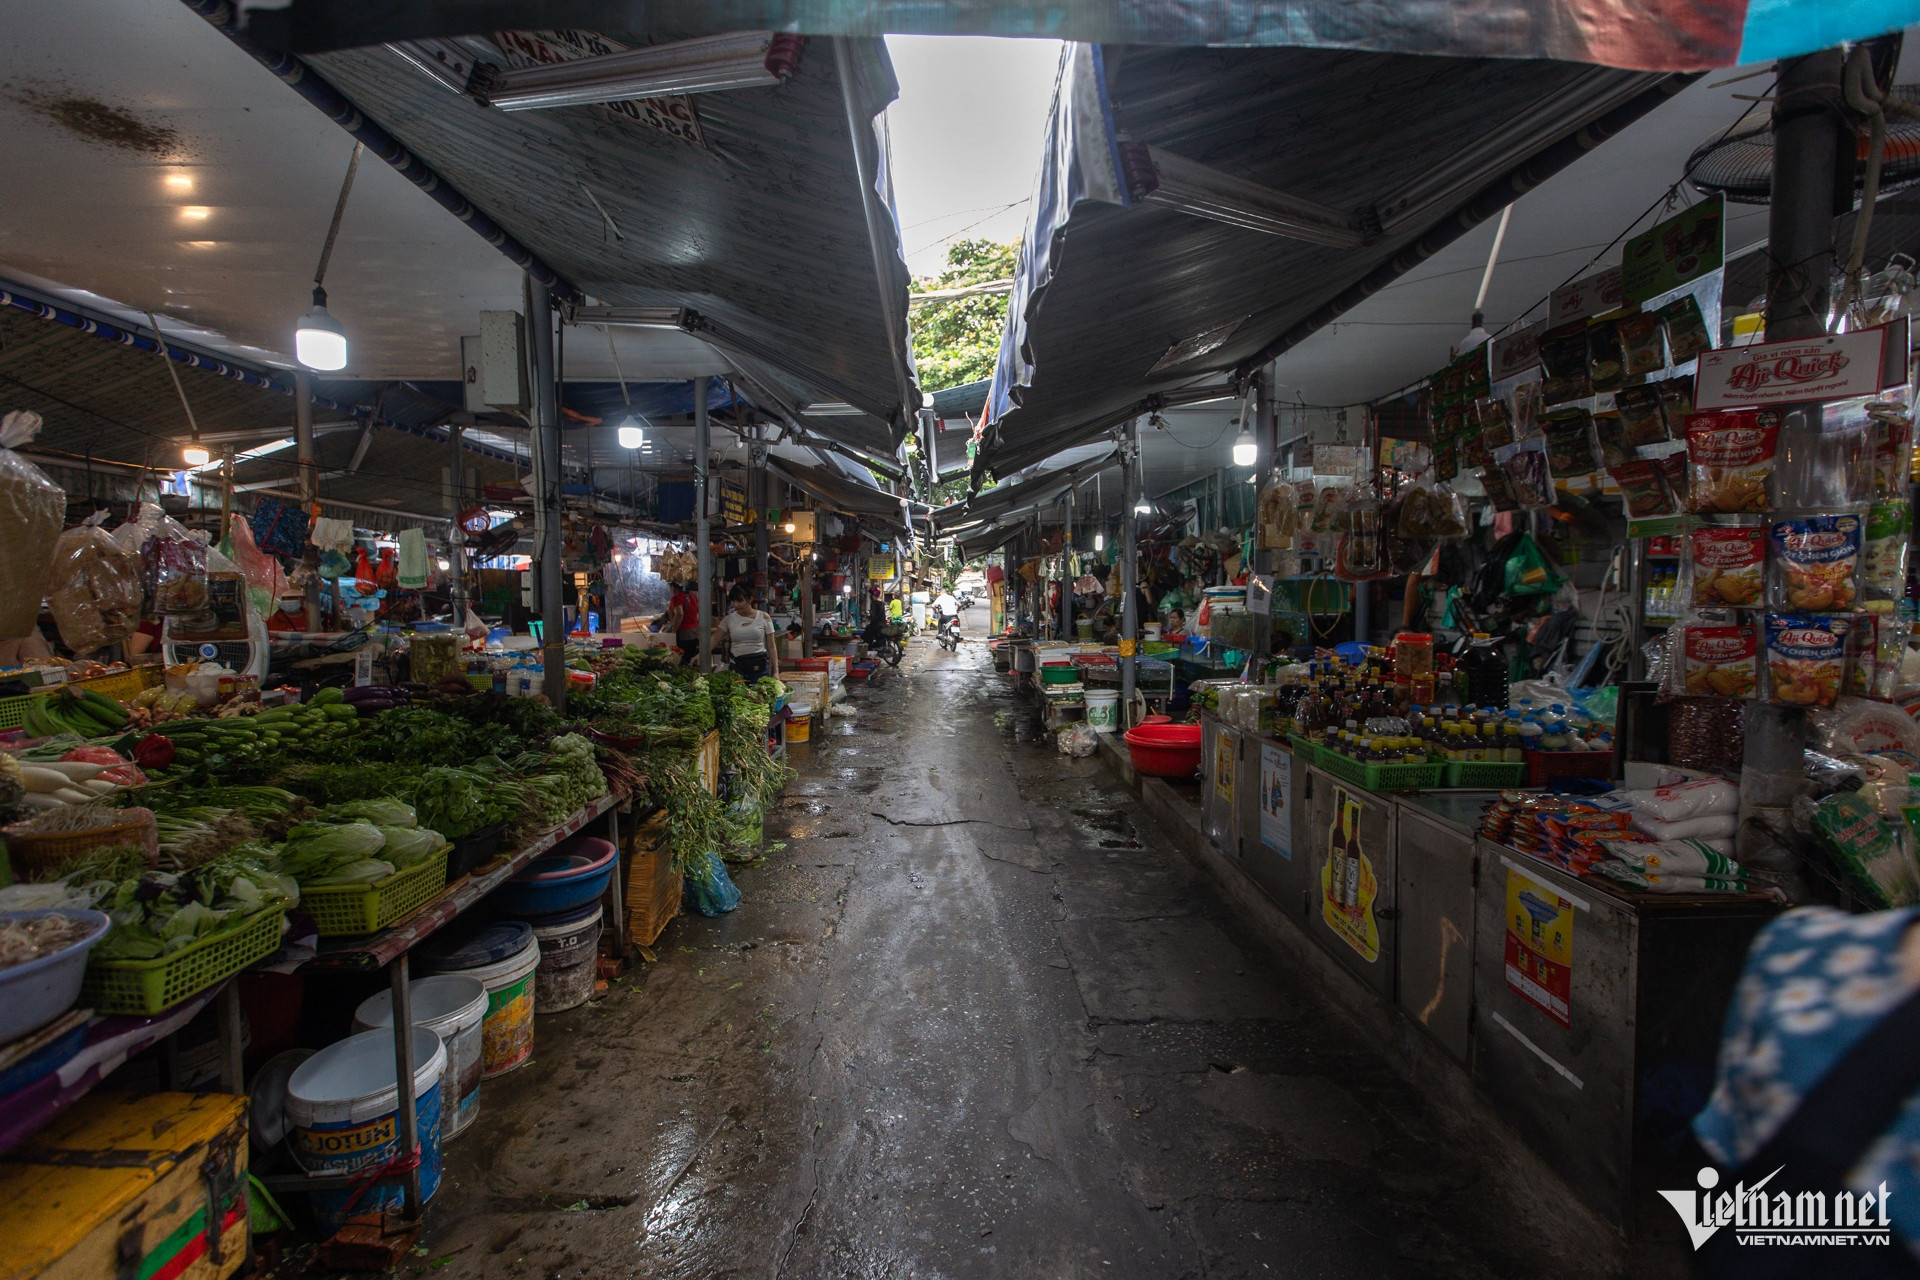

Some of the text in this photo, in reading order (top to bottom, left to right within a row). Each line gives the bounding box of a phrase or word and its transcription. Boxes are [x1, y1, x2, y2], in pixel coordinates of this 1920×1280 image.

[1726, 350, 1847, 391] Aji-Quick
[1700, 431, 1762, 449] Aji-Quick
[1780, 631, 1834, 646] Aji-Quick
[317, 1123, 390, 1152] JOTUN
